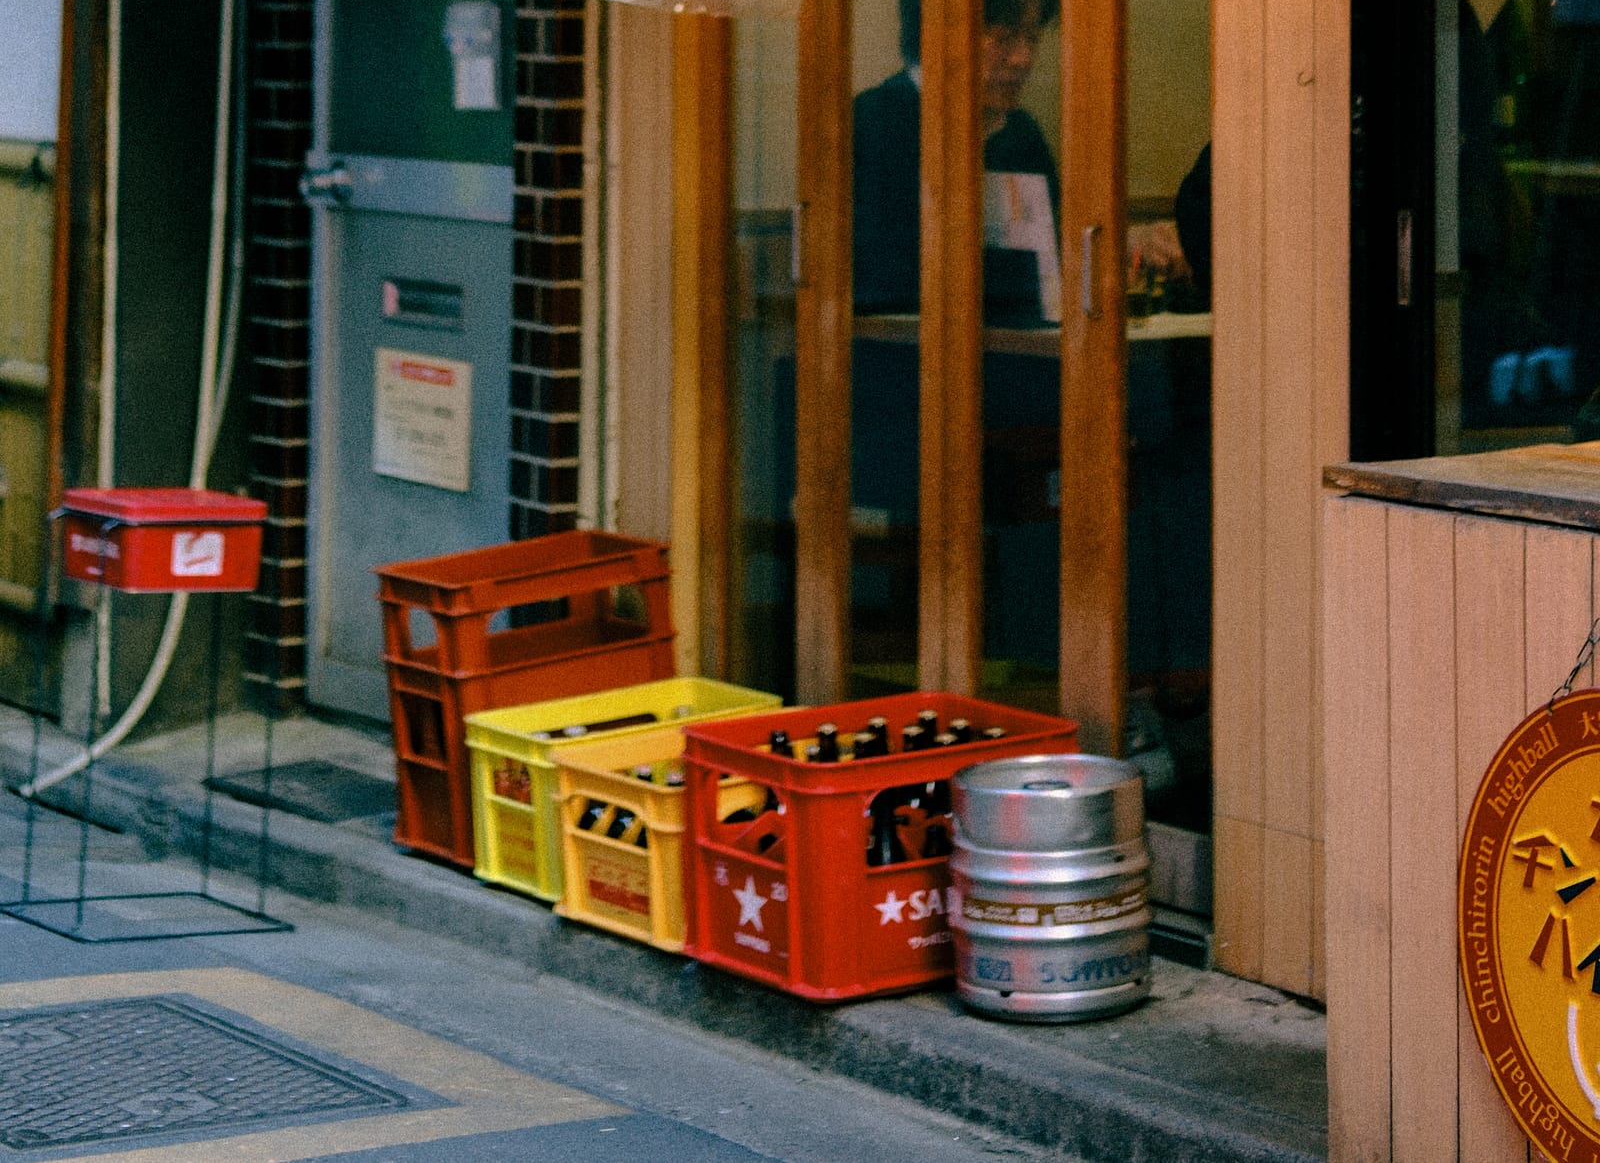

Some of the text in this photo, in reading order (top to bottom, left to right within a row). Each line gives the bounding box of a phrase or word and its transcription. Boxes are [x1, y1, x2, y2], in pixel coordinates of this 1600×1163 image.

[1577, 711, 1600, 739] 大
[1467, 722, 1560, 1024] chinchirorin highball
[1495, 1046, 1576, 1162] highball
